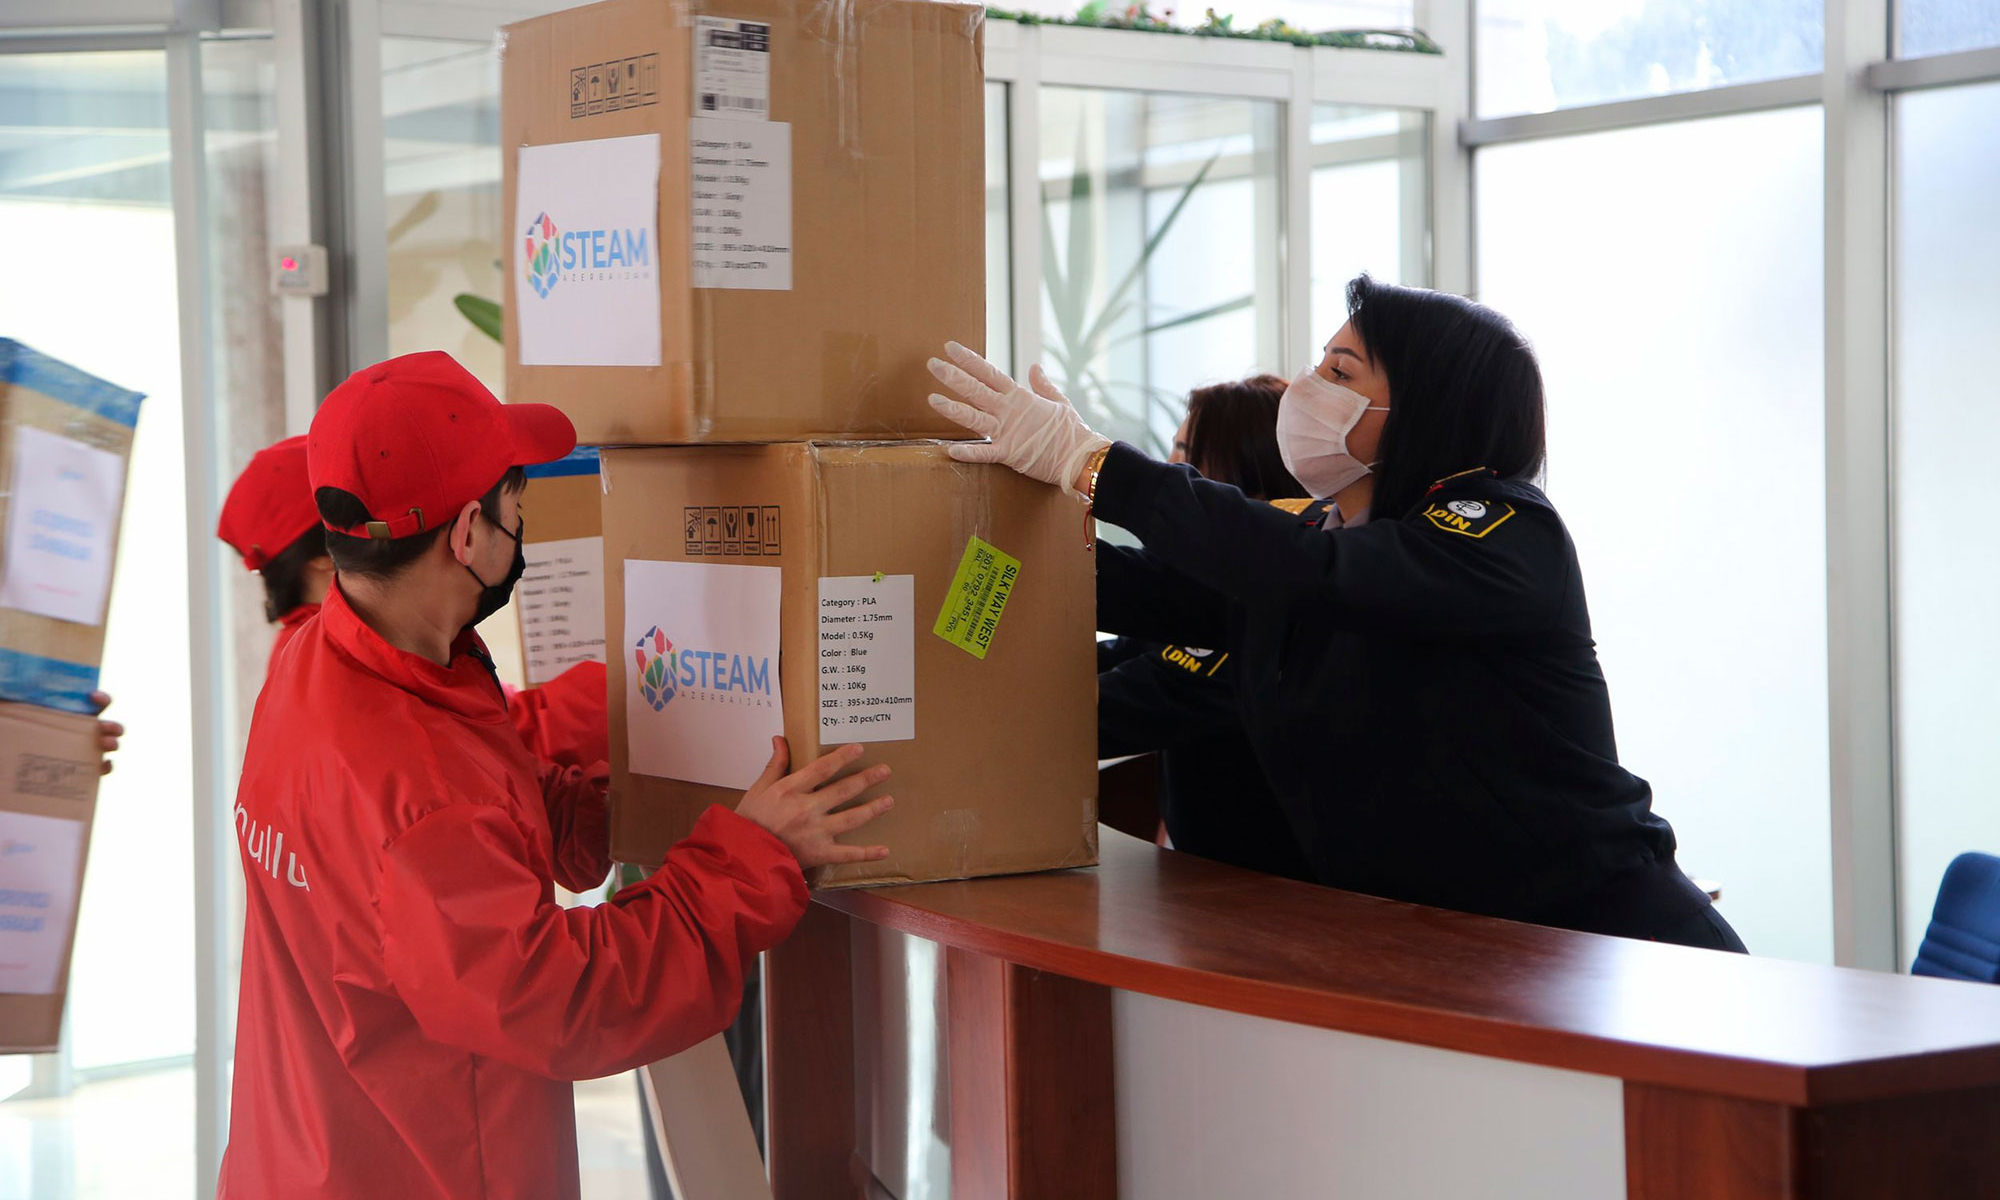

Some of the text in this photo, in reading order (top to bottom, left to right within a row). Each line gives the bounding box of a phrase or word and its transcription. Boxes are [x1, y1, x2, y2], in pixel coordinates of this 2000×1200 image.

[562, 227, 649, 270] STEAM
[821, 598, 856, 608] Category
[862, 597, 877, 605] PLA
[975, 564, 1017, 650] SILK WAY WEST
[821, 615, 856, 624] Diameter
[862, 613, 893, 622] 1.75mm
[821, 631, 846, 640] Model
[852, 630, 874, 640] 0.5Kg
[821, 649, 842, 657] Color
[851, 648, 868, 656] Blue
[680, 649, 771, 696] STEAM
[821, 666, 840, 674] G.W.
[846, 665, 866, 674] 16Kg
[821, 683, 841, 691] N.W.
[847, 682, 867, 691] 10Kg
[822, 699, 838, 708] SIZE
[848, 715, 859, 723] 20
[860, 713, 891, 724] pcs/CTN
